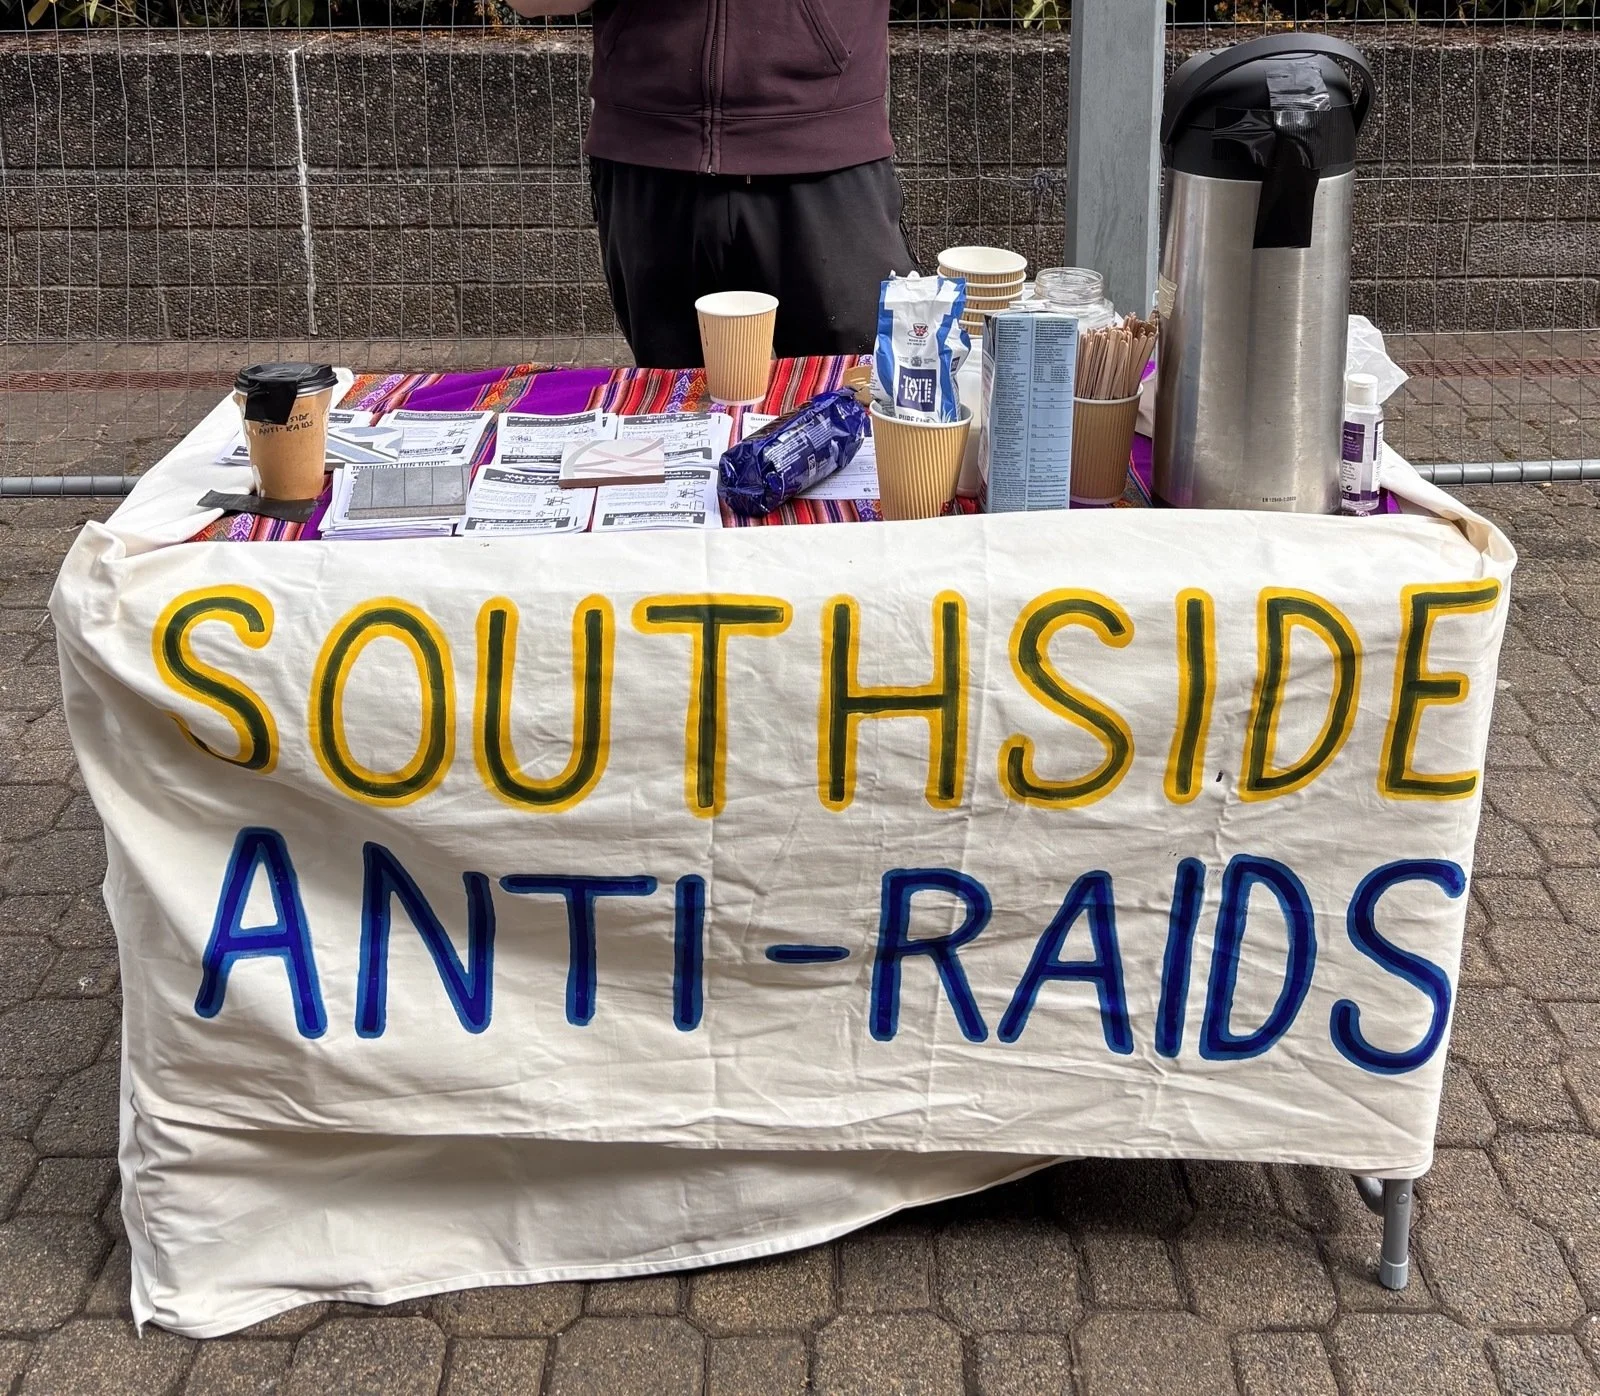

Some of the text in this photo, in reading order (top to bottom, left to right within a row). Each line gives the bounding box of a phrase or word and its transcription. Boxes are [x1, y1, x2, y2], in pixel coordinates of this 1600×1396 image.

[902, 375, 933, 391] TATE
[904, 388, 933, 403] LYLE
[152, 579, 1501, 819] SOUTHSIDE
[194, 827, 1468, 1076] ANTI-RAIDS
